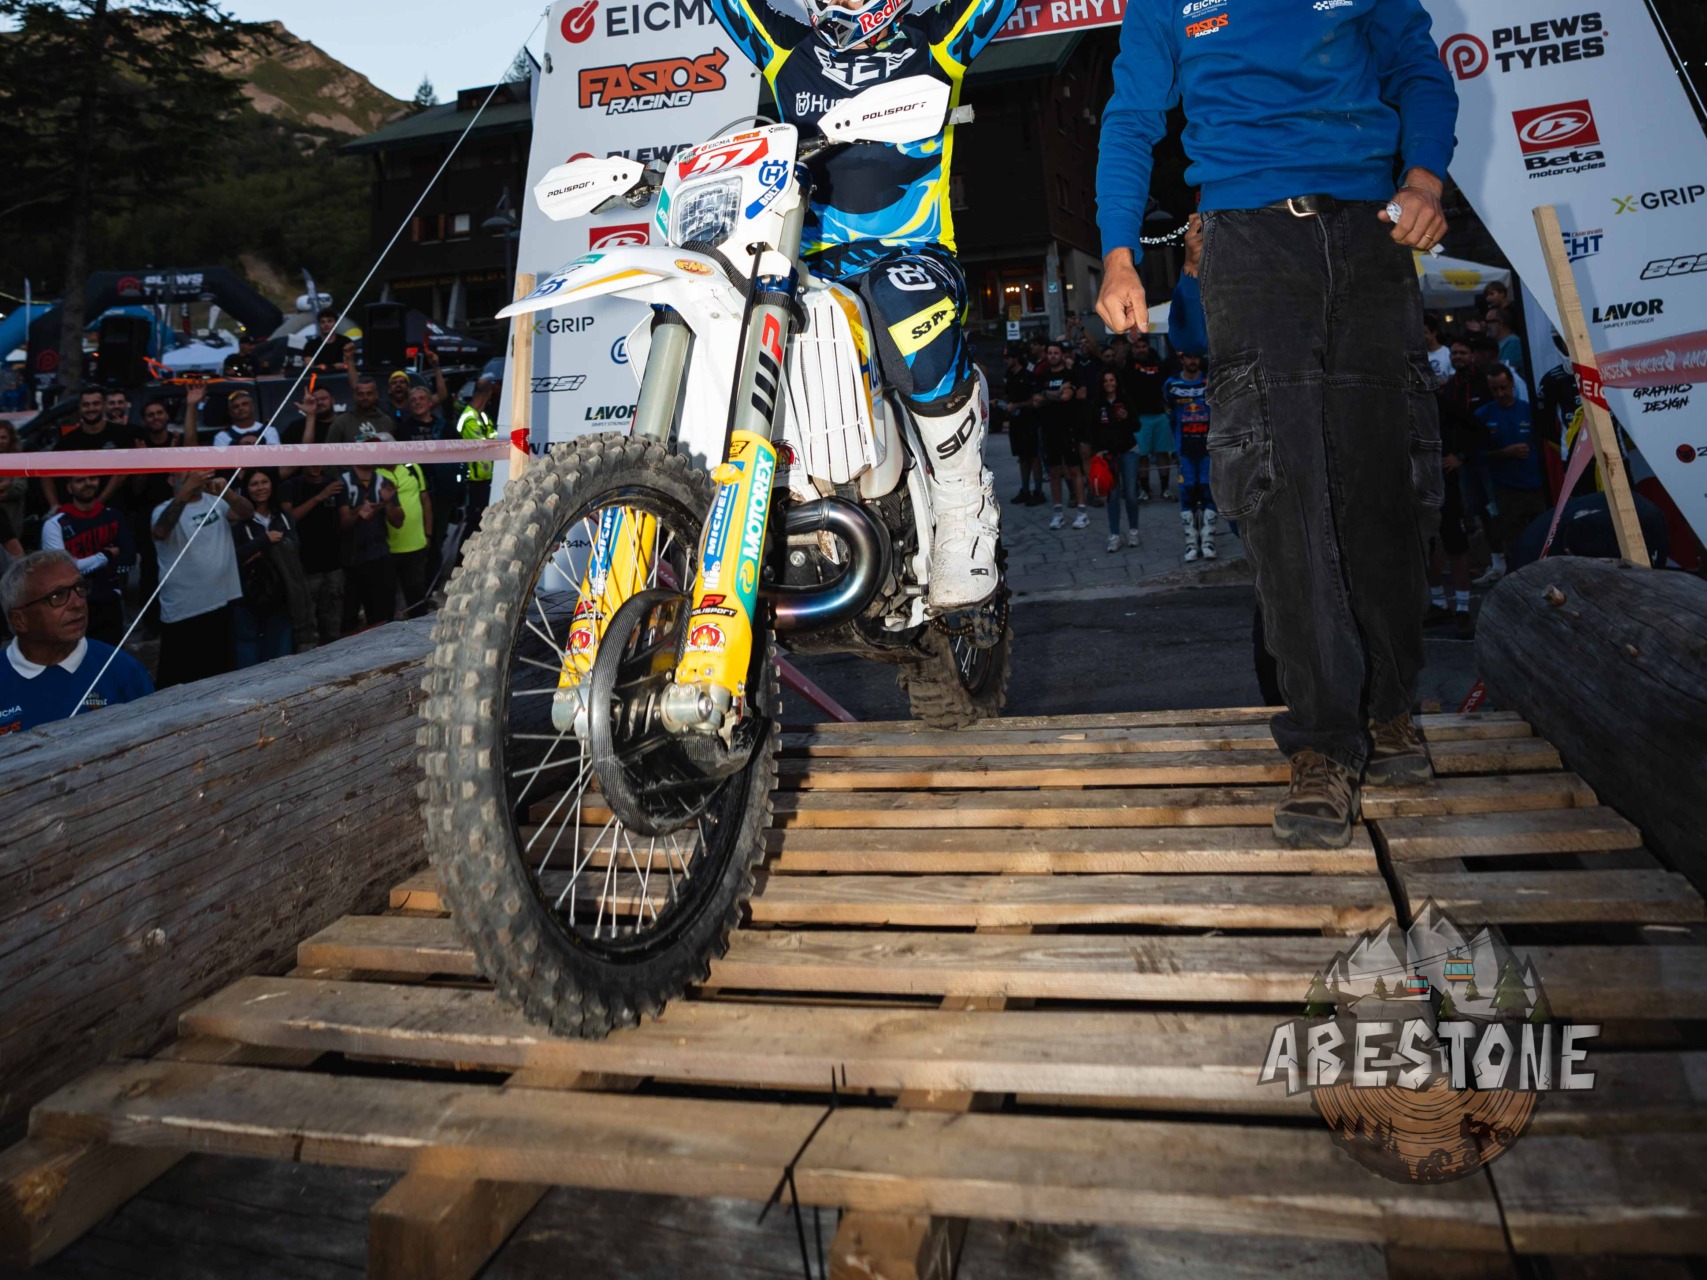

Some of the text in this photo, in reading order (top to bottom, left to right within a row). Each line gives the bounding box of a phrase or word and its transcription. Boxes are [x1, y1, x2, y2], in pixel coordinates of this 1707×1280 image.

[1000, 5, 1042, 32] HT
[1492, 11, 1603, 49] PLEWS
[1495, 36, 1605, 73] TYRES
[606, 91, 693, 115] RACING
[708, 139, 731, 149] EICMA
[1524, 150, 1604, 170] Beta
[1529, 162, 1606, 179] motorcycles
[759, 187, 781, 206] BOLT
[1611, 184, 1706, 215] X-GRIP
[1562, 232, 1604, 257] HT
[1592, 298, 1664, 323] LAVOR
[1642, 396, 1690, 414] DESIGN
[742, 452, 774, 561] MOTOREX
[706, 483, 731, 556] MICHEL
